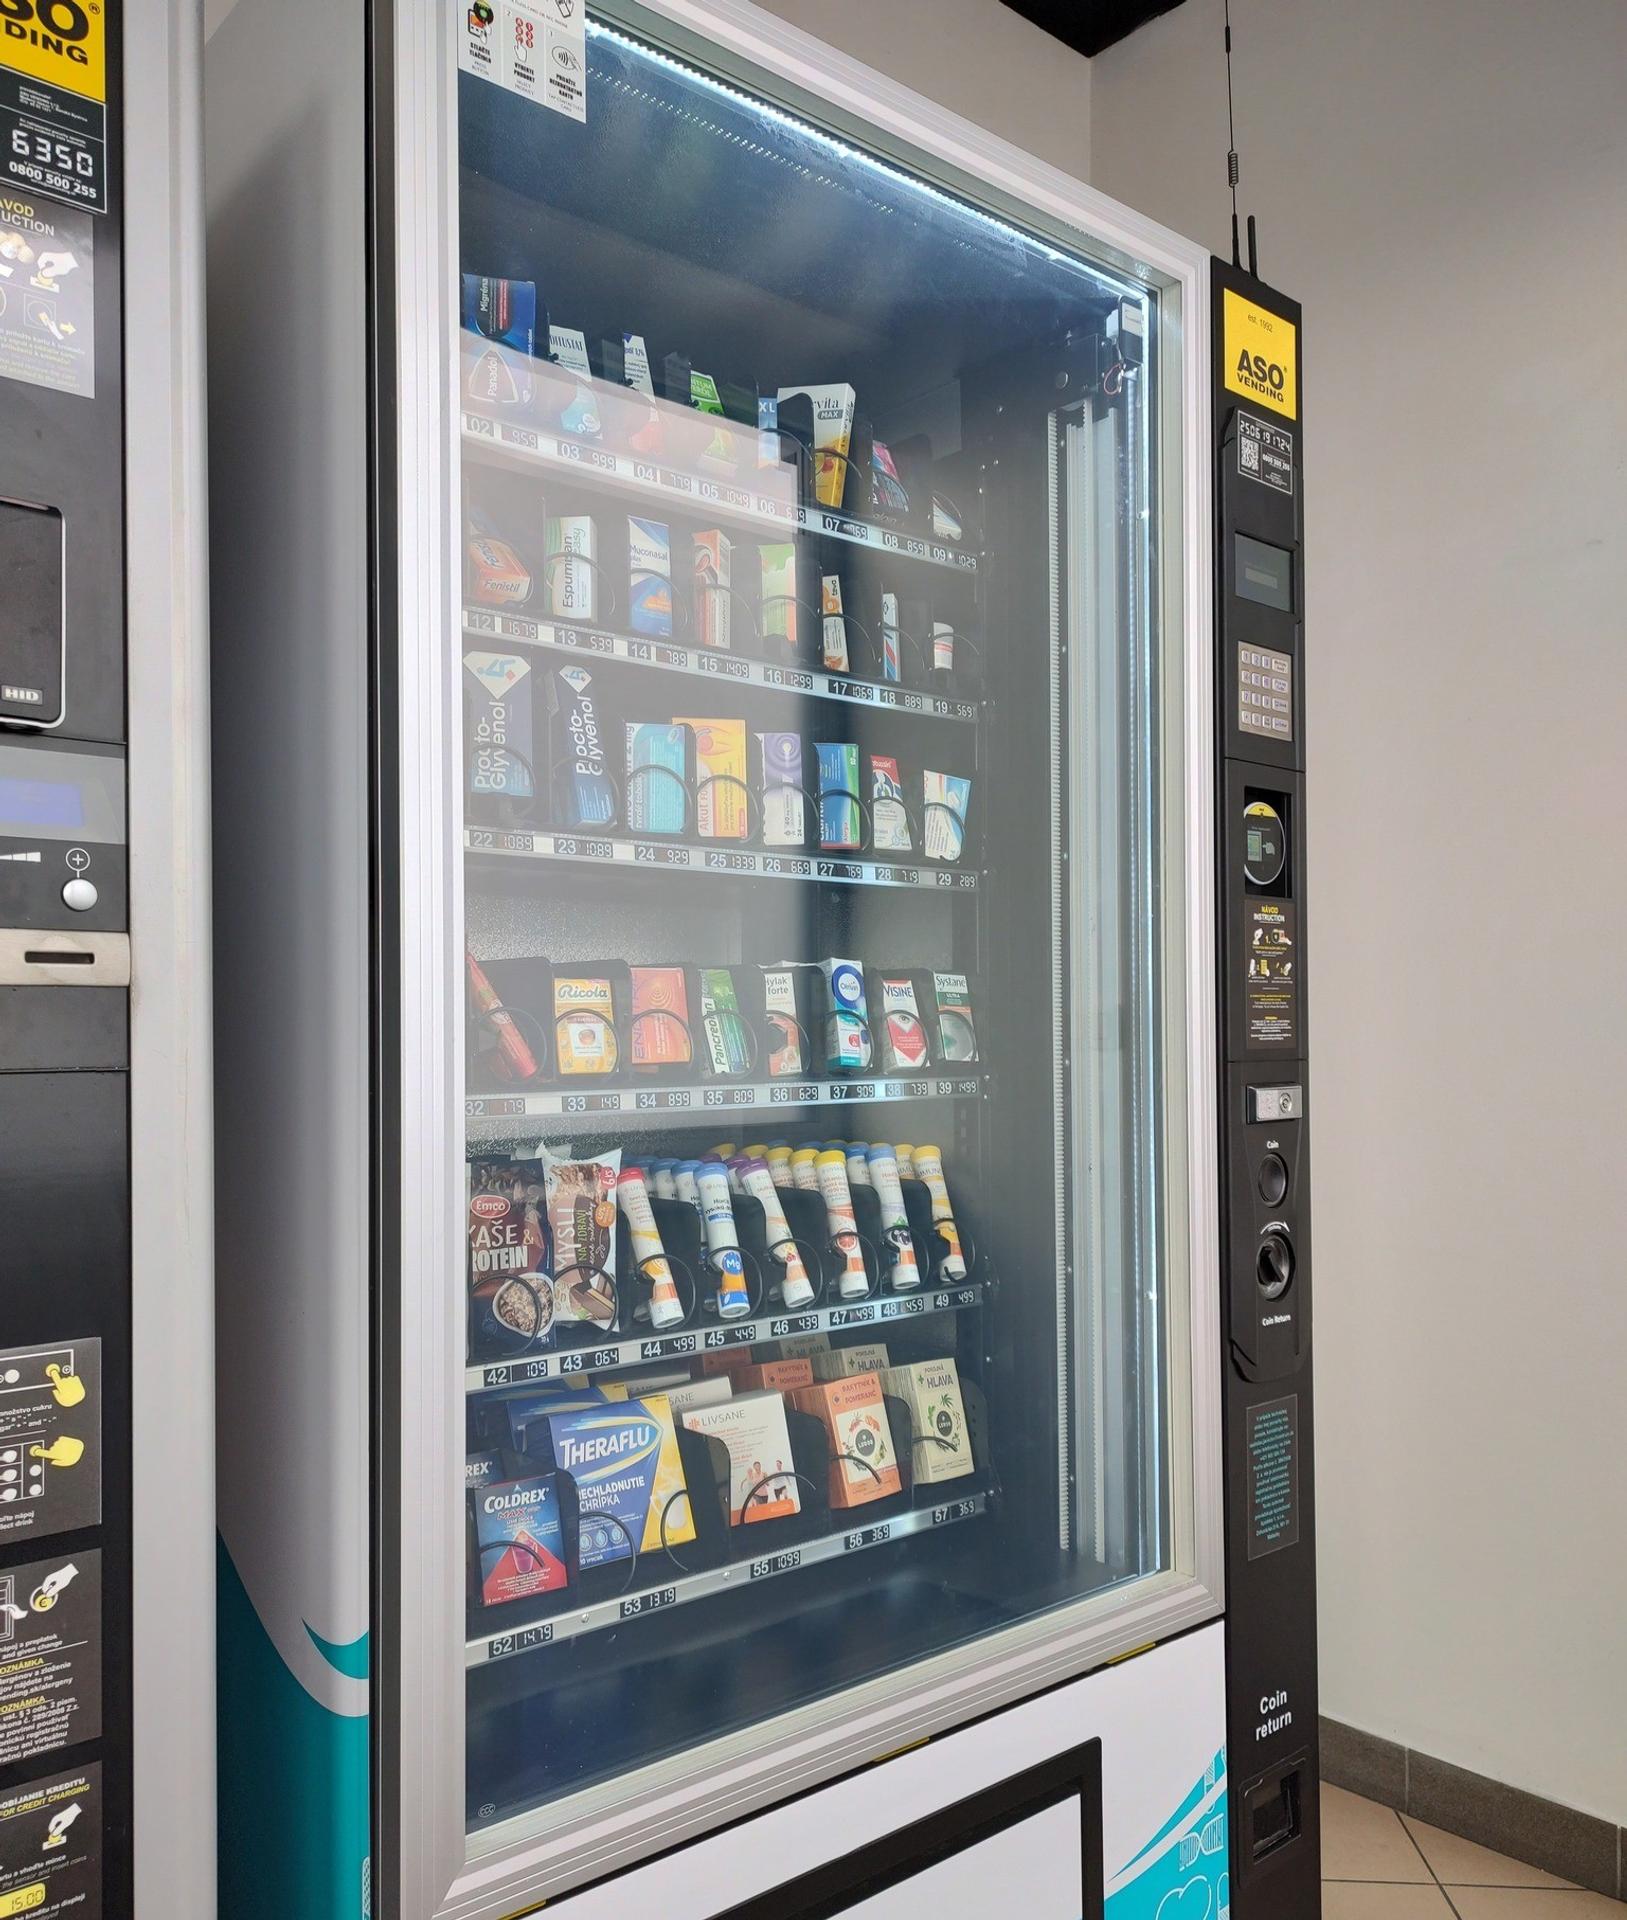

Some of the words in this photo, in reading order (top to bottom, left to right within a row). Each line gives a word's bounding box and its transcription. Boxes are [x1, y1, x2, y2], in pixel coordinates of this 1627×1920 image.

[12, 129, 93, 177] 6350
[9, 161, 42, 181] 0800
[46, 172, 70, 190] 500
[73, 183, 97, 199] 255
[1248, 314, 1257, 326] est.
[1260, 319, 1273, 332] 1992
[1238, 349, 1284, 390] ASO
[488, 357, 498, 397] Panadol
[1237, 372, 1284, 403] VENDING
[813, 397, 839, 410] vita
[820, 410, 839, 419] MAX
[470, 418, 490, 434] 02
[1263, 431, 1271, 444] 19
[562, 444, 580, 460] 03
[638, 465, 655, 480] 04
[702, 482, 719, 498] 05
[760, 496, 776, 514] 06
[825, 517, 839, 531] 07
[886, 533, 899, 548] 08
[933, 548, 947, 561] 09
[486, 579, 520, 593] Fenistil
[472, 614, 492, 627] 12
[558, 631, 577, 646] 13
[632, 645, 648, 658] 14
[701, 657, 717, 671] 15
[767, 669, 782, 683] 16
[5, 688, 39, 701] HID
[833, 683, 848, 696] 17
[882, 691, 896, 704] 18
[936, 700, 948, 714] 19
[490, 701, 509, 790] Glyvenol
[473, 832, 493, 848] 22
[558, 839, 577, 854] 23
[638, 847, 656, 861] 24
[710, 854, 727, 868] 25
[766, 859, 781, 872] 26
[820, 863, 834, 876] 27
[878, 867, 892, 880] 28
[938, 872, 951, 885] 29
[936, 974, 966, 989] Systane
[557, 985, 608, 999] Ricola
[768, 984, 789, 995] forte
[884, 985, 914, 998] VISINE
[774, 1088, 788, 1101] 36
[833, 1086, 847, 1099] 37
[939, 1082, 952, 1094] 39
[567, 1097, 586, 1111] 33
[639, 1094, 656, 1107] 34
[707, 1091, 723, 1104] 35
[466, 1101, 485, 1116] 32
[1266, 1140, 1279, 1149] Coin
[476, 1200, 506, 1212] Emco
[523, 1229, 534, 1245] &
[936, 1294, 949, 1308] 49
[883, 1303, 897, 1316] 48
[832, 1311, 847, 1324] 47
[1262, 1315, 1273, 1326] Coin
[1274, 1313, 1291, 1324] Return
[773, 1321, 789, 1335] 46
[707, 1332, 725, 1346] 45
[645, 1342, 661, 1357] 44
[563, 1355, 582, 1371] 43
[487, 1368, 507, 1384] 42
[926, 1374, 953, 1389] HLAVA
[701, 1409, 746, 1426] LIVSANE
[559, 1425, 650, 1469] THERAFLU
[484, 1487, 546, 1514] COLDREX
[934, 1509, 948, 1523] 57
[849, 1535, 863, 1548] 56
[753, 1563, 769, 1577] 55
[624, 1596, 642, 1615] 53
[492, 1637, 512, 1655] 52
[1259, 1690, 1288, 1715] Coin
[1255, 1711, 1292, 1742] return
[46, 1777, 86, 1795] KREDITU
